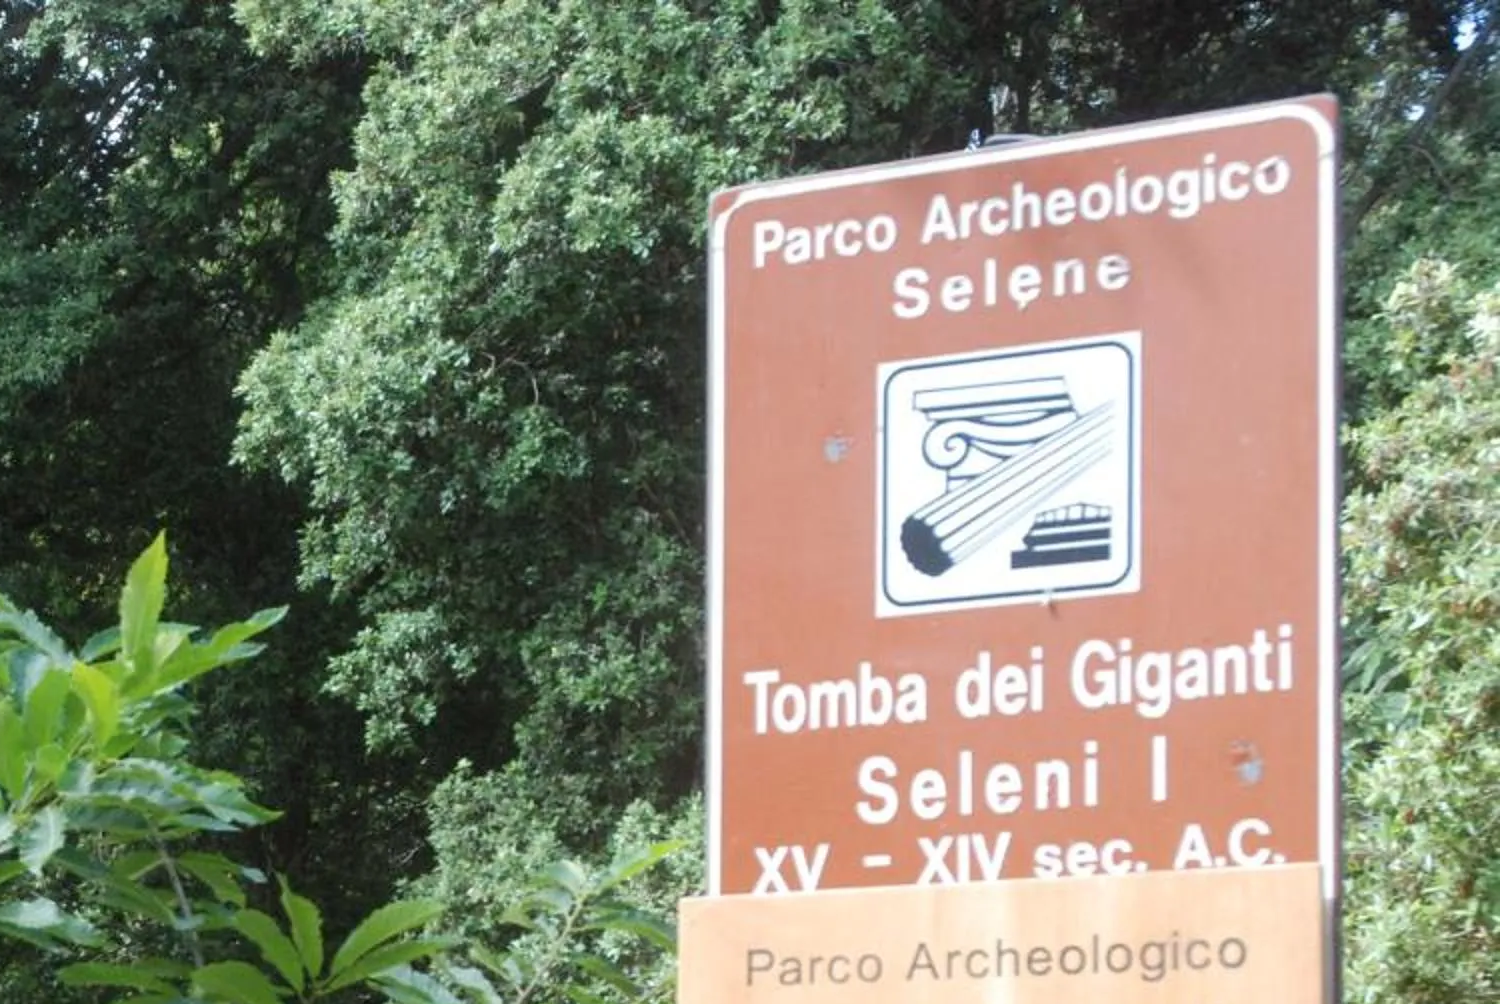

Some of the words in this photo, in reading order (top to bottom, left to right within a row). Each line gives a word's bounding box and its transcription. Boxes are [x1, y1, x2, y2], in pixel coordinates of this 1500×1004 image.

[752, 213, 897, 268] Parco
[921, 153, 1291, 243] Archeologico
[892, 253, 1132, 319] Selene
[744, 661, 927, 734] Tomba
[956, 646, 1044, 718] dei
[1071, 624, 1294, 719] Giganti
[856, 740, 1099, 824] Seleni
[1152, 735, 1167, 802] I
[754, 843, 830, 894] XV
[916, 831, 1012, 885] XIV
[1033, 838, 1148, 880] sec.
[1174, 818, 1287, 871] A.C.
[746, 948, 883, 986] Parco
[906, 931, 1248, 981] Archeologico
